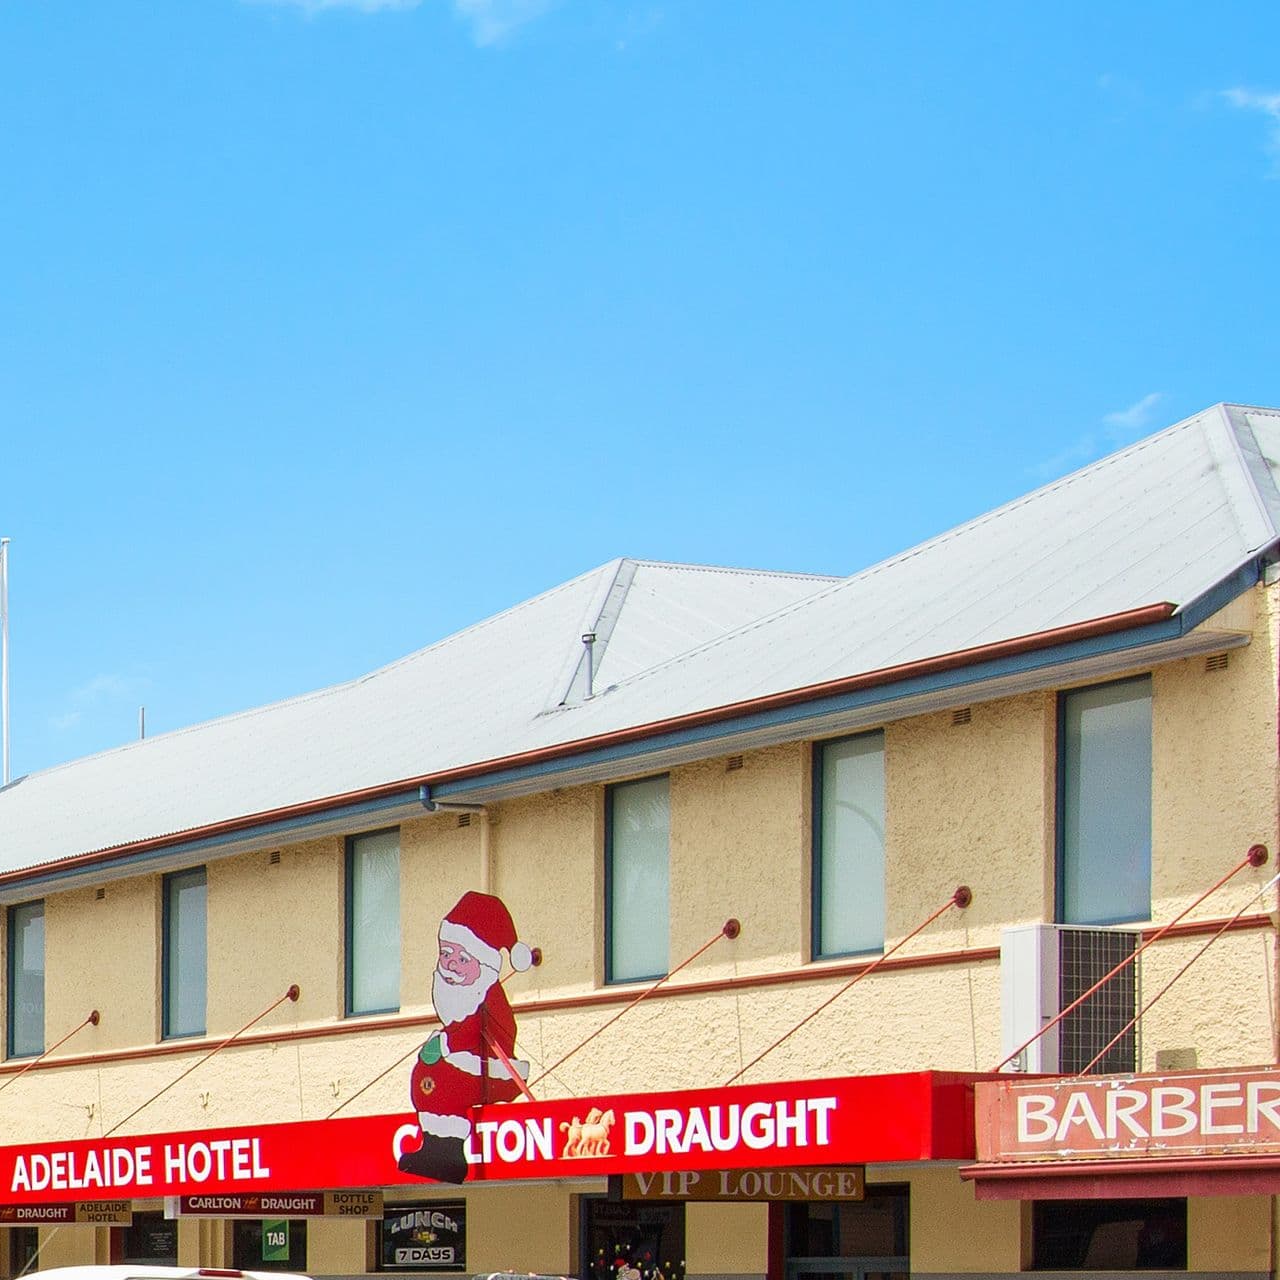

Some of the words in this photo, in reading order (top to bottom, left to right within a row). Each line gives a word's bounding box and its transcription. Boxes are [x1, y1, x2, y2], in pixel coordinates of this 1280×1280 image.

[392, 1117, 554, 1165] CLTON
[624, 1097, 837, 1157] DRAUGHT
[11, 1147, 153, 1193] ADELAIDE
[164, 1138, 270, 1183] HOTEL
[634, 1170, 702, 1197] VIP
[719, 1170, 857, 1197] LOUNGE
[188, 1196, 241, 1210] CARLTON
[260, 1196, 316, 1211] DRAUGHT
[332, 1193, 374, 1204] BOTTLE
[16, 1207, 69, 1219] DRAUGHT
[79, 1203, 128, 1213] ADELAIDE
[338, 1204, 369, 1215] SHOP
[87, 1213, 120, 1223] HOTEL
[391, 1210, 458, 1234] LUNCH
[267, 1231, 285, 1246] TAB
[399, 1250, 408, 1261] 7
[412, 1249, 451, 1261] DAYS
